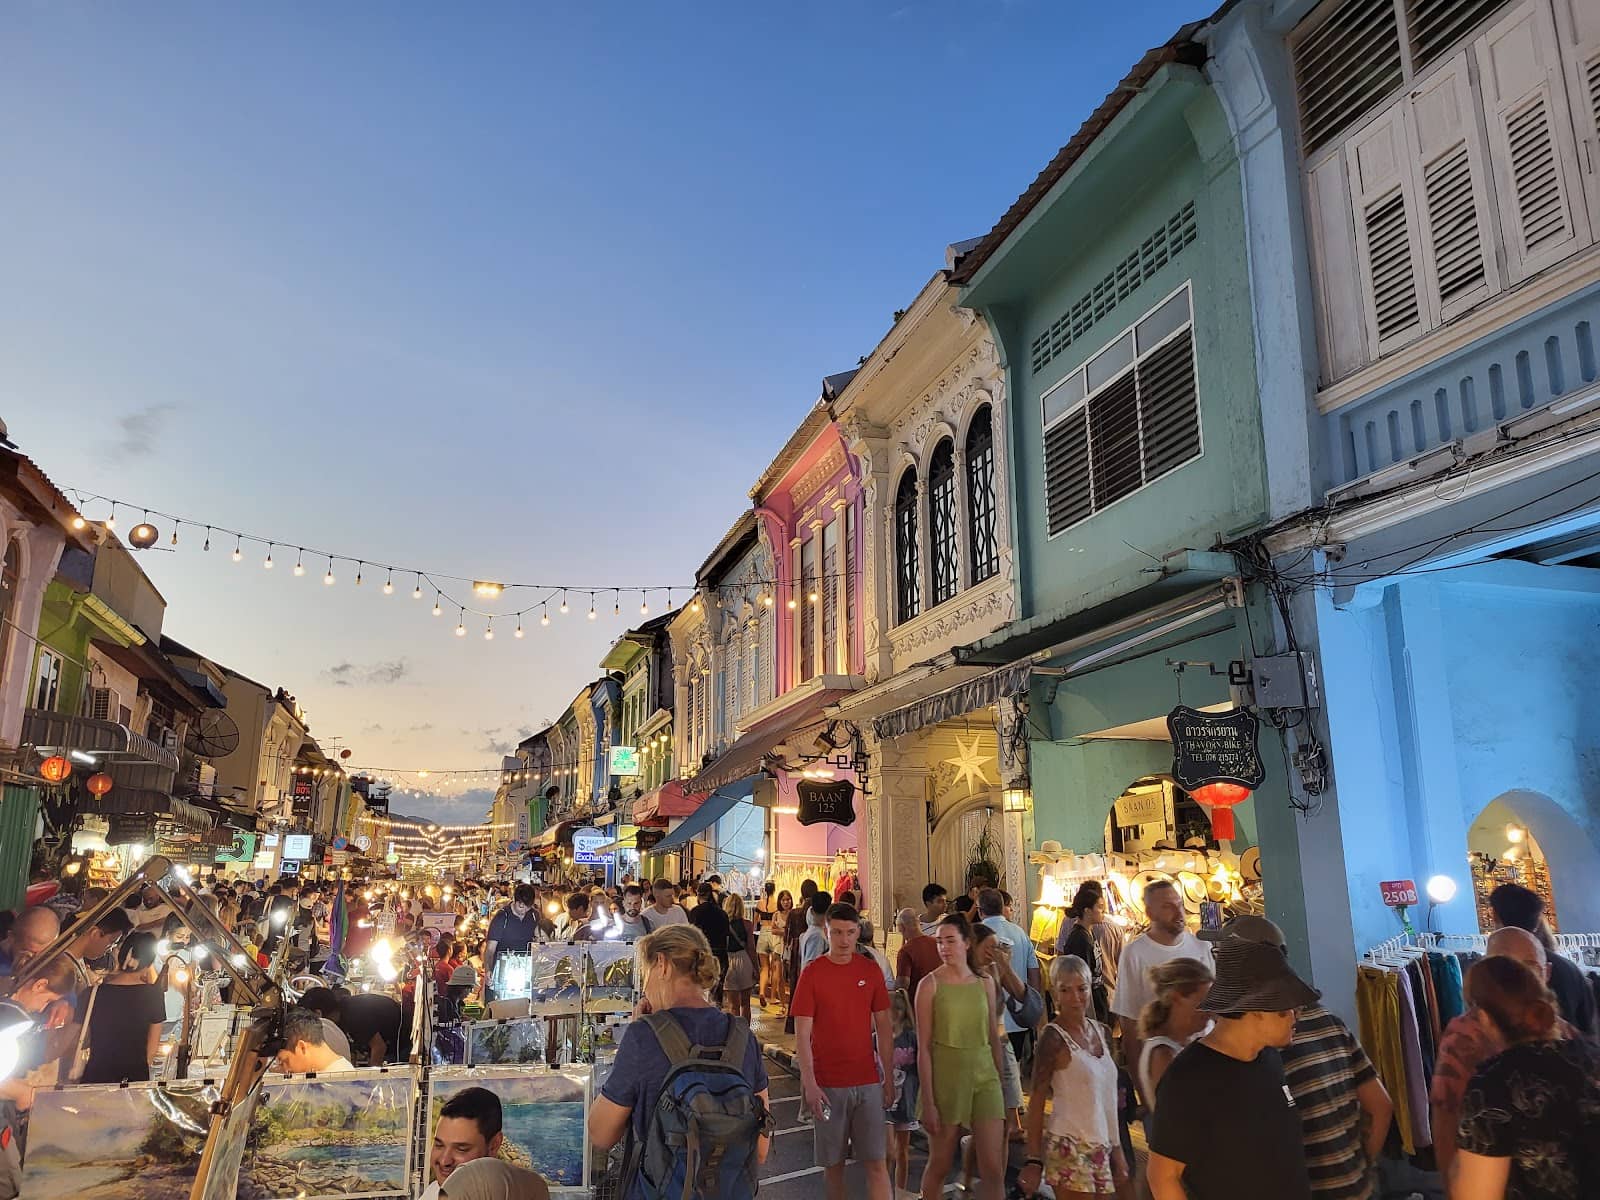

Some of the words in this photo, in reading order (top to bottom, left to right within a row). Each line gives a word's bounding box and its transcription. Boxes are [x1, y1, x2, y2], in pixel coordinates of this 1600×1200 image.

[809, 791, 842, 802] BAAN
[818, 802, 835, 813] 125
[576, 852, 613, 863] Exchange
